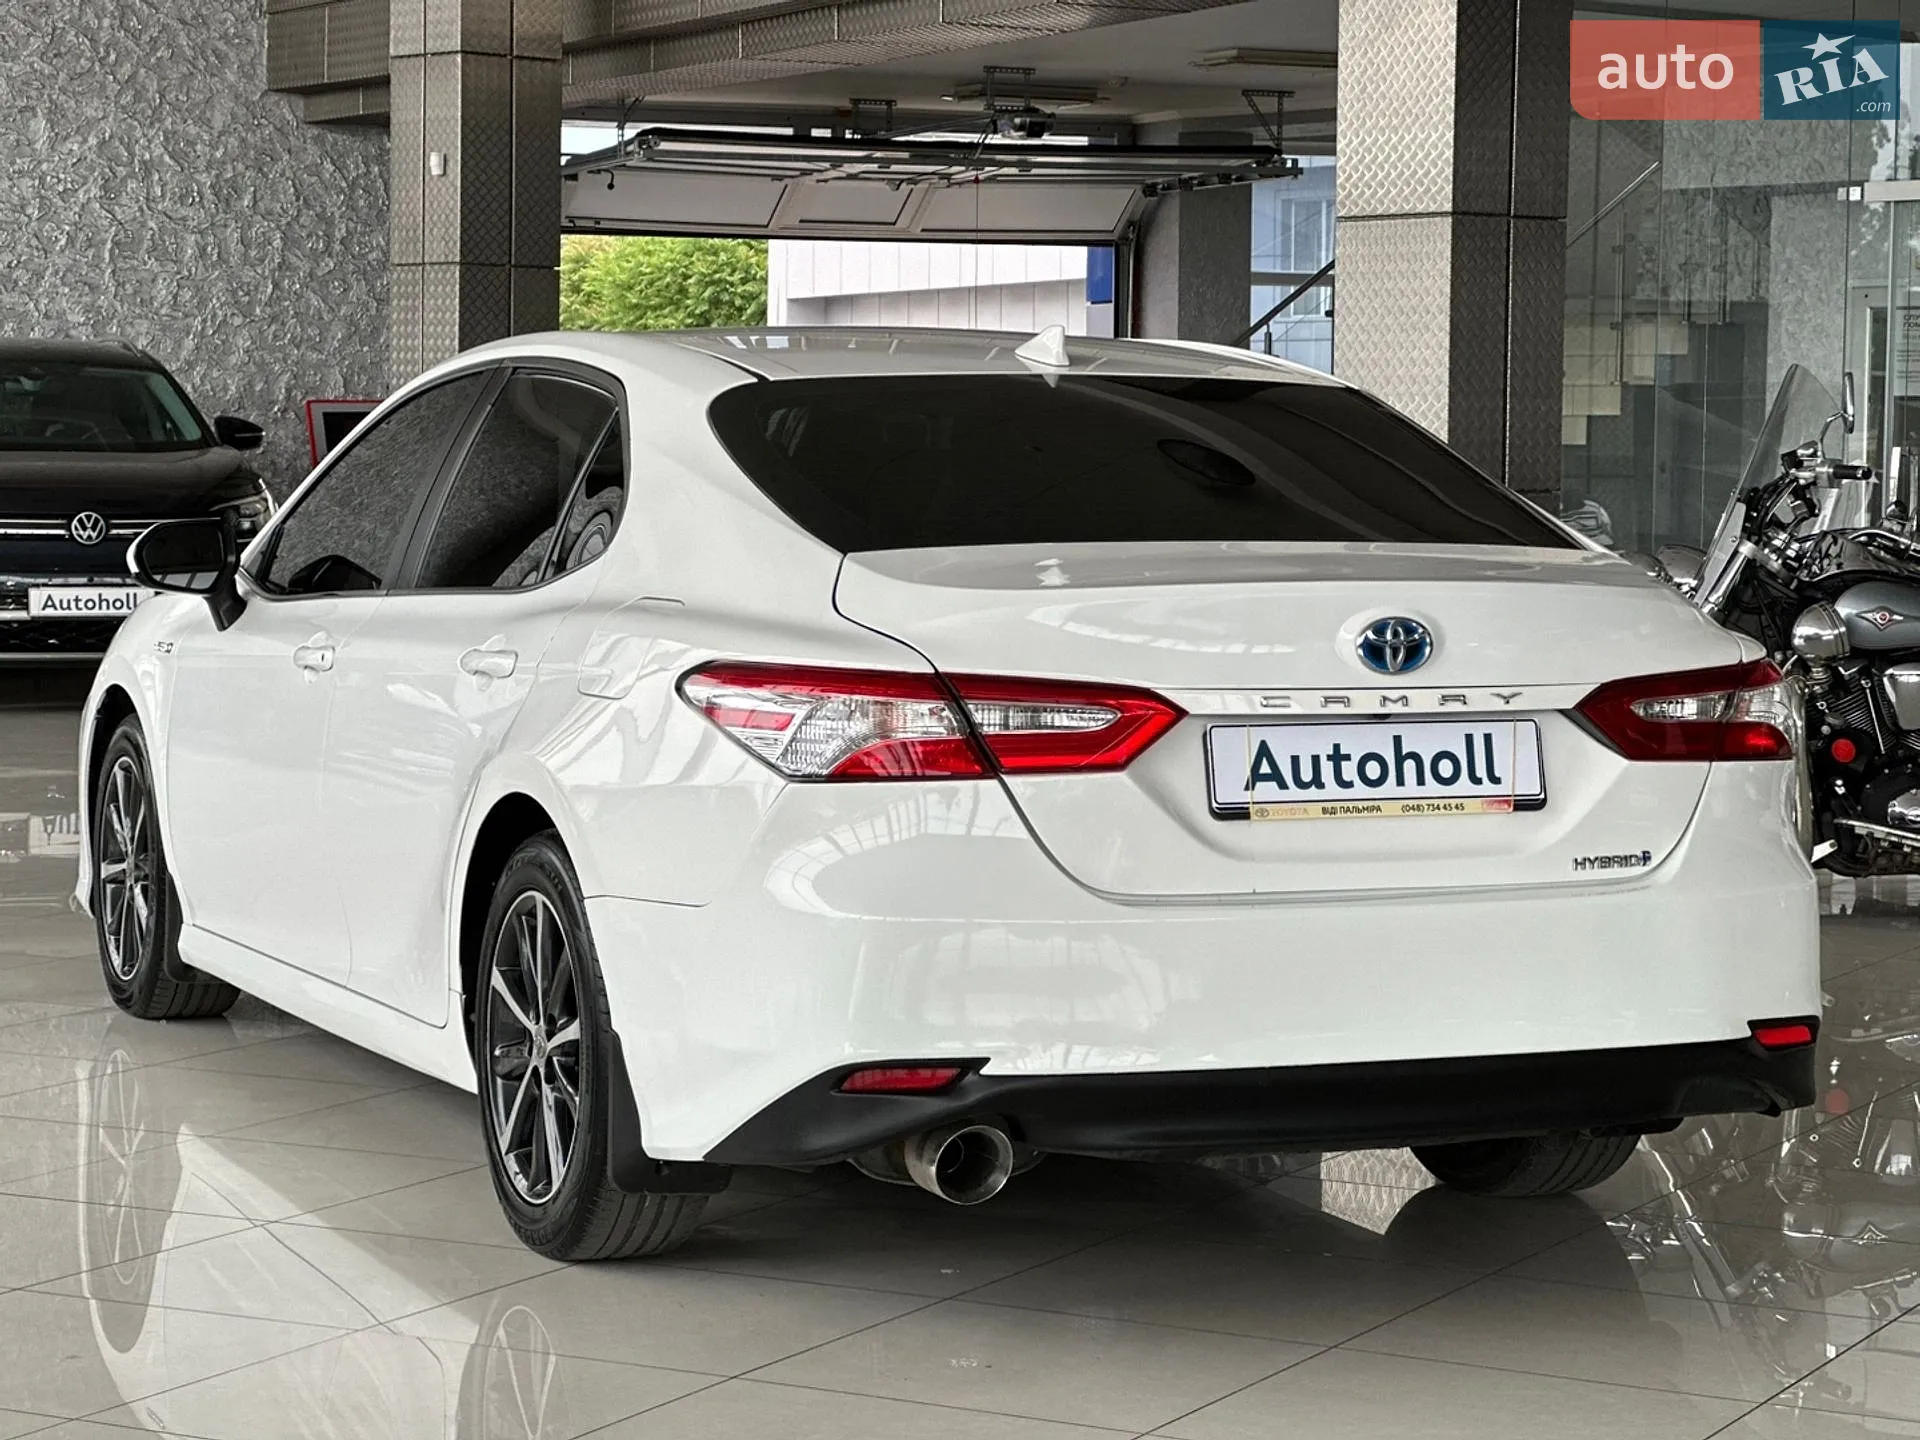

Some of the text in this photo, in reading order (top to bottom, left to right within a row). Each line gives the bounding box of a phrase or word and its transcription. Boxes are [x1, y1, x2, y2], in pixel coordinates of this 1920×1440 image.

[41, 592, 138, 611] Autoholl
[1260, 692, 1523, 708] CAMRY
[1243, 732, 1502, 791] Autoholl
[1339, 804, 1383, 814] ПАЛЬМІРА
[1401, 803, 1425, 813] (048)
[1426, 803, 1441, 812] 734
[1573, 854, 1641, 871] HYBRID
